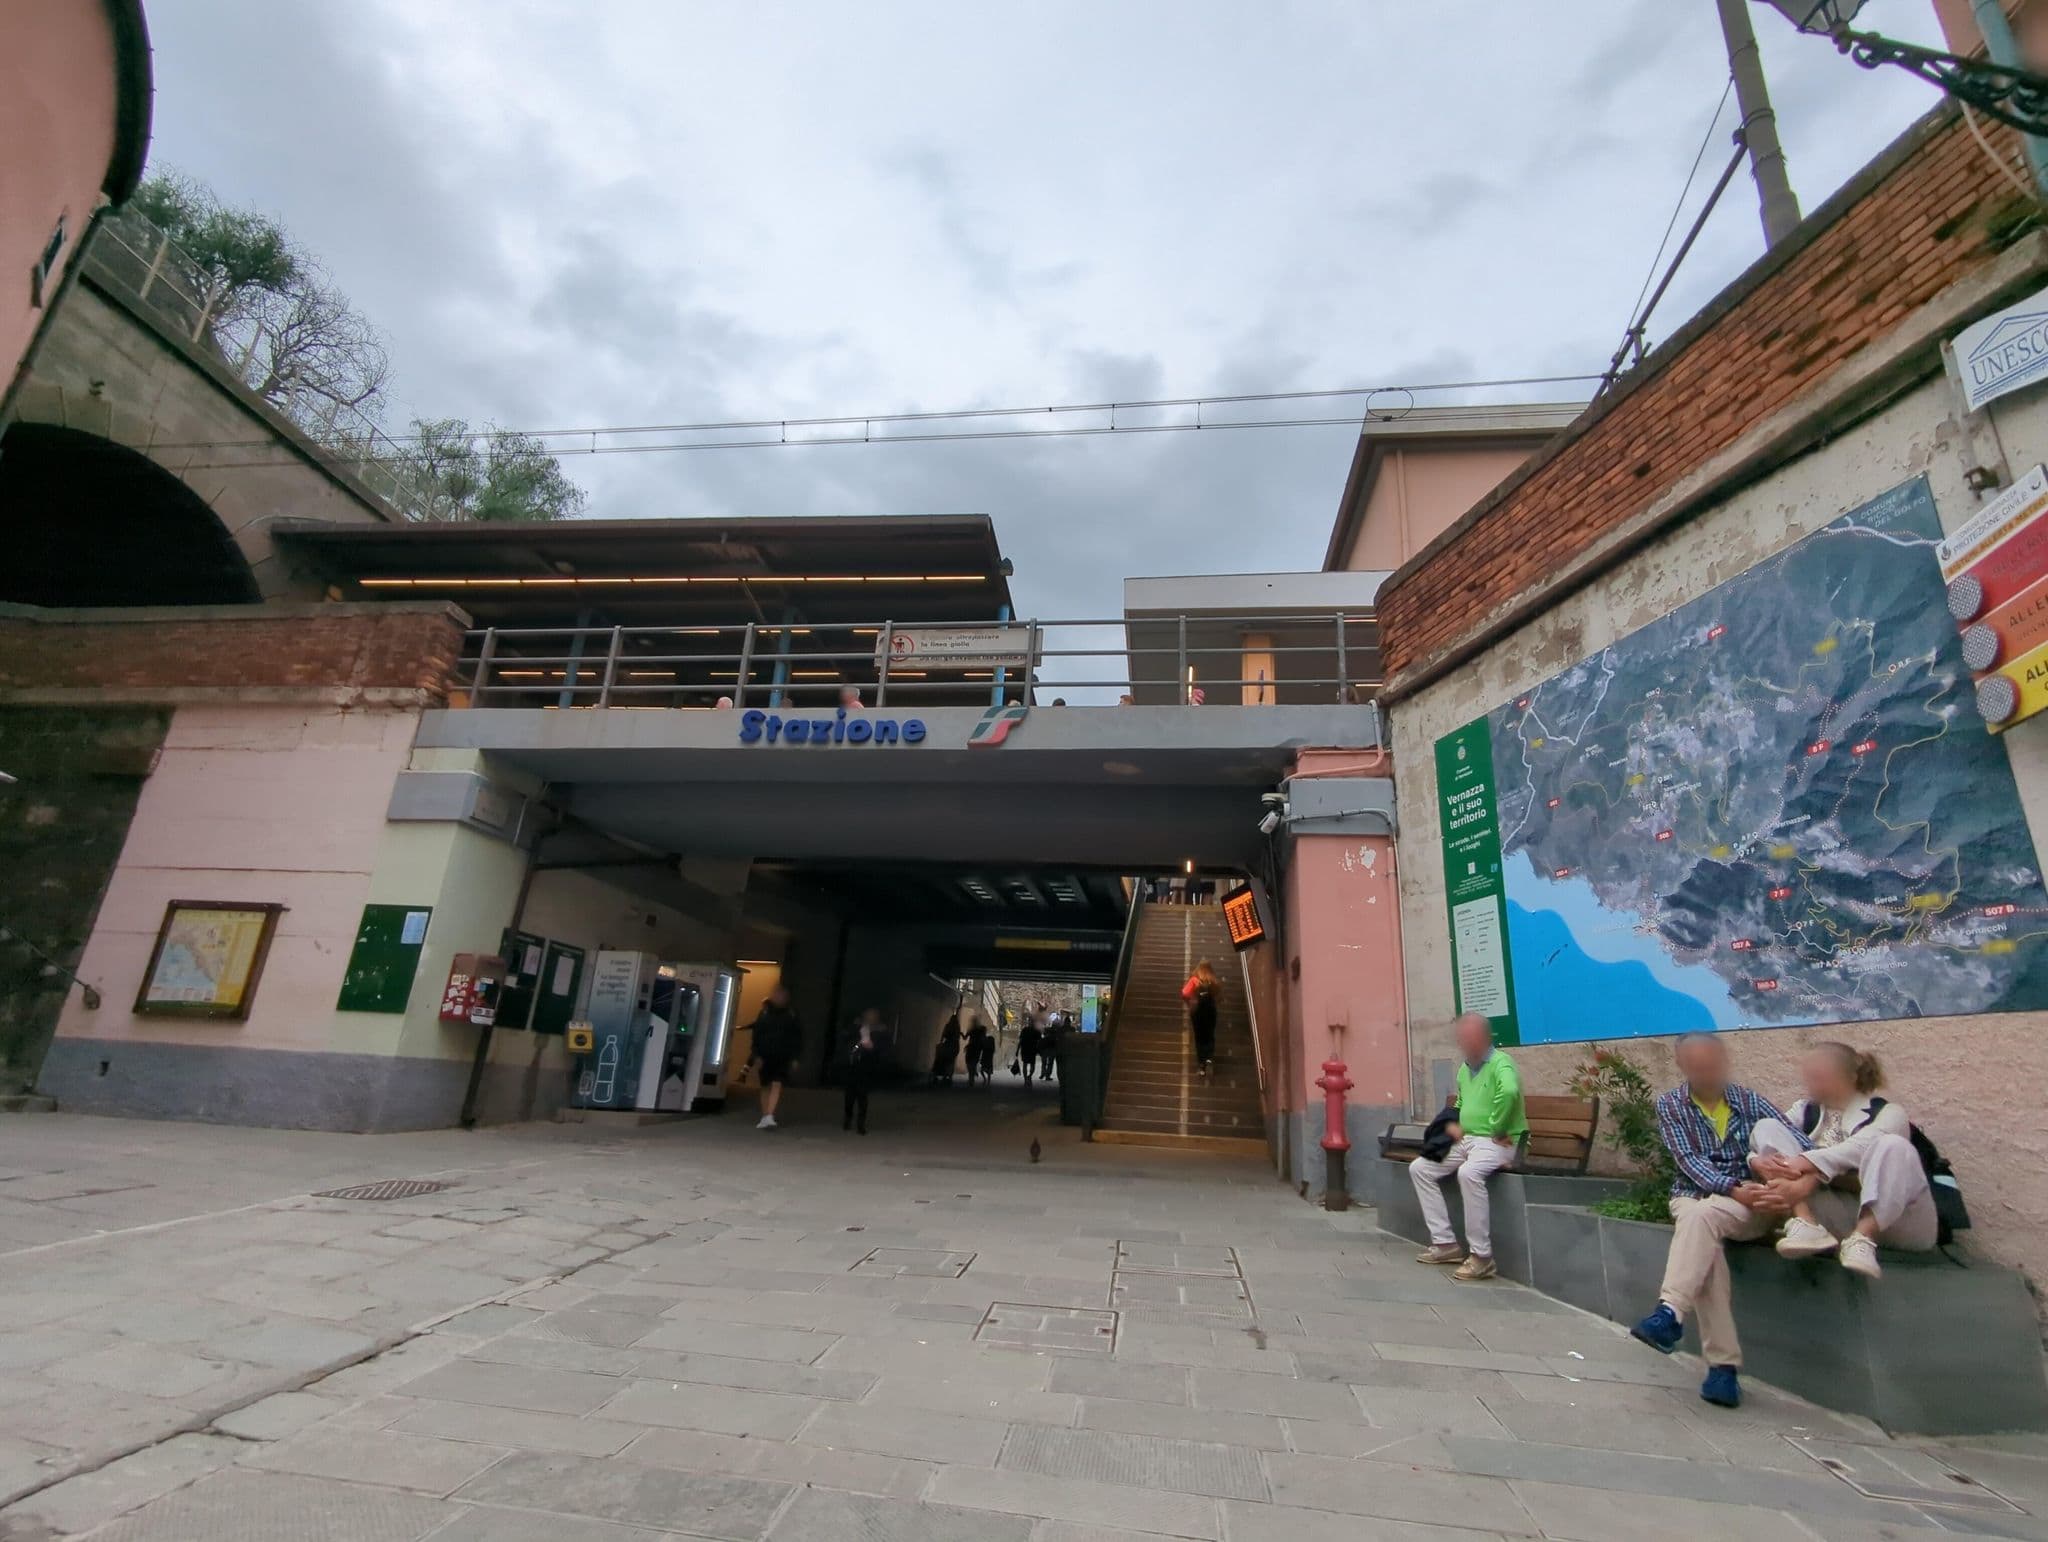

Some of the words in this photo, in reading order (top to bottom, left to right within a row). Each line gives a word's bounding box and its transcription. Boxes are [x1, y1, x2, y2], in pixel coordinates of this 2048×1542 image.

[739, 708, 926, 744] Stazione
[1447, 783, 1485, 806] Vernazza
[1449, 807, 1487, 830] territorio
[1451, 808, 1458, 817] e
[1459, 803, 1465, 813] il
[1466, 797, 1482, 810] suo
[1985, 907, 2003, 916] 507
